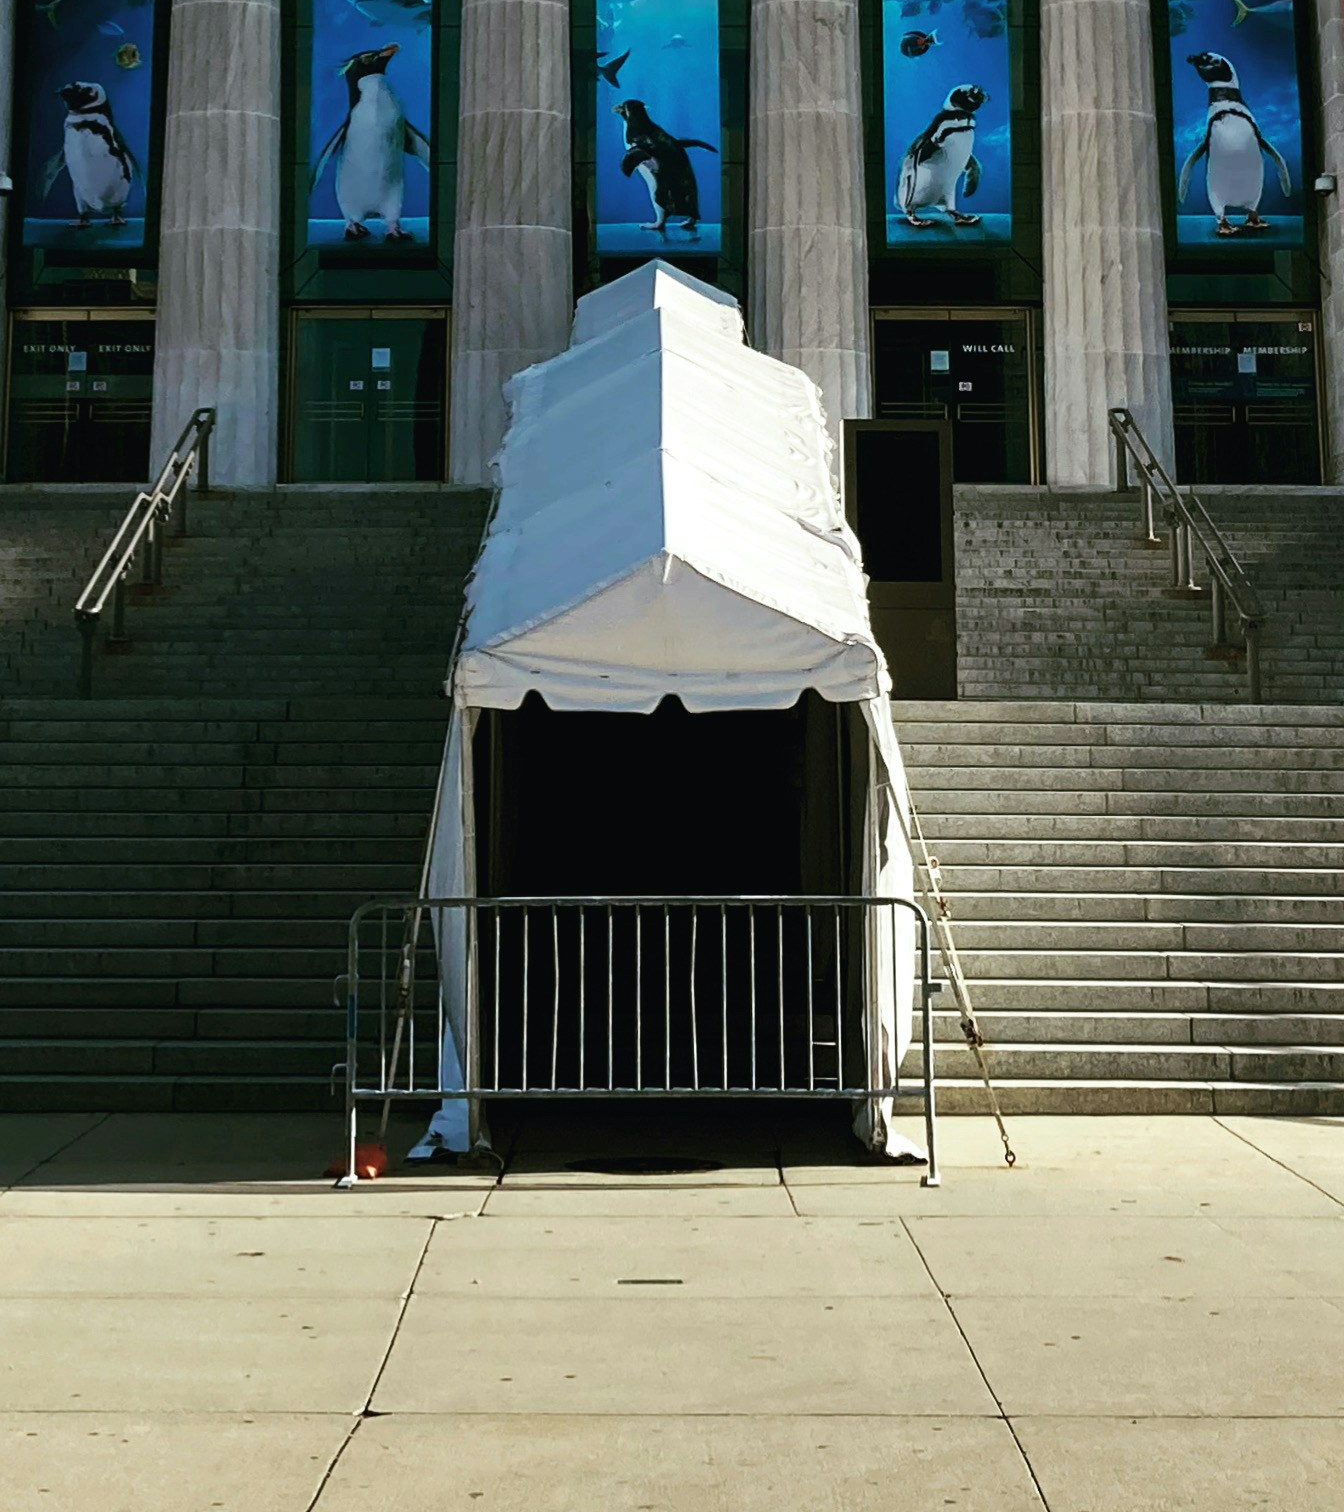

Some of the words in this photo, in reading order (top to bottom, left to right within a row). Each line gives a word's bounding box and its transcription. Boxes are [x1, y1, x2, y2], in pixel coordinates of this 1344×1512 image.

[23, 345, 45, 353] EXIT
[49, 345, 76, 353] ONLY
[99, 345, 121, 353] EXIT
[124, 345, 152, 353] ONLY
[962, 344, 988, 353] WILL
[990, 344, 1015, 353] CALL
[1243, 346, 1308, 355] MEMBERSHIP
